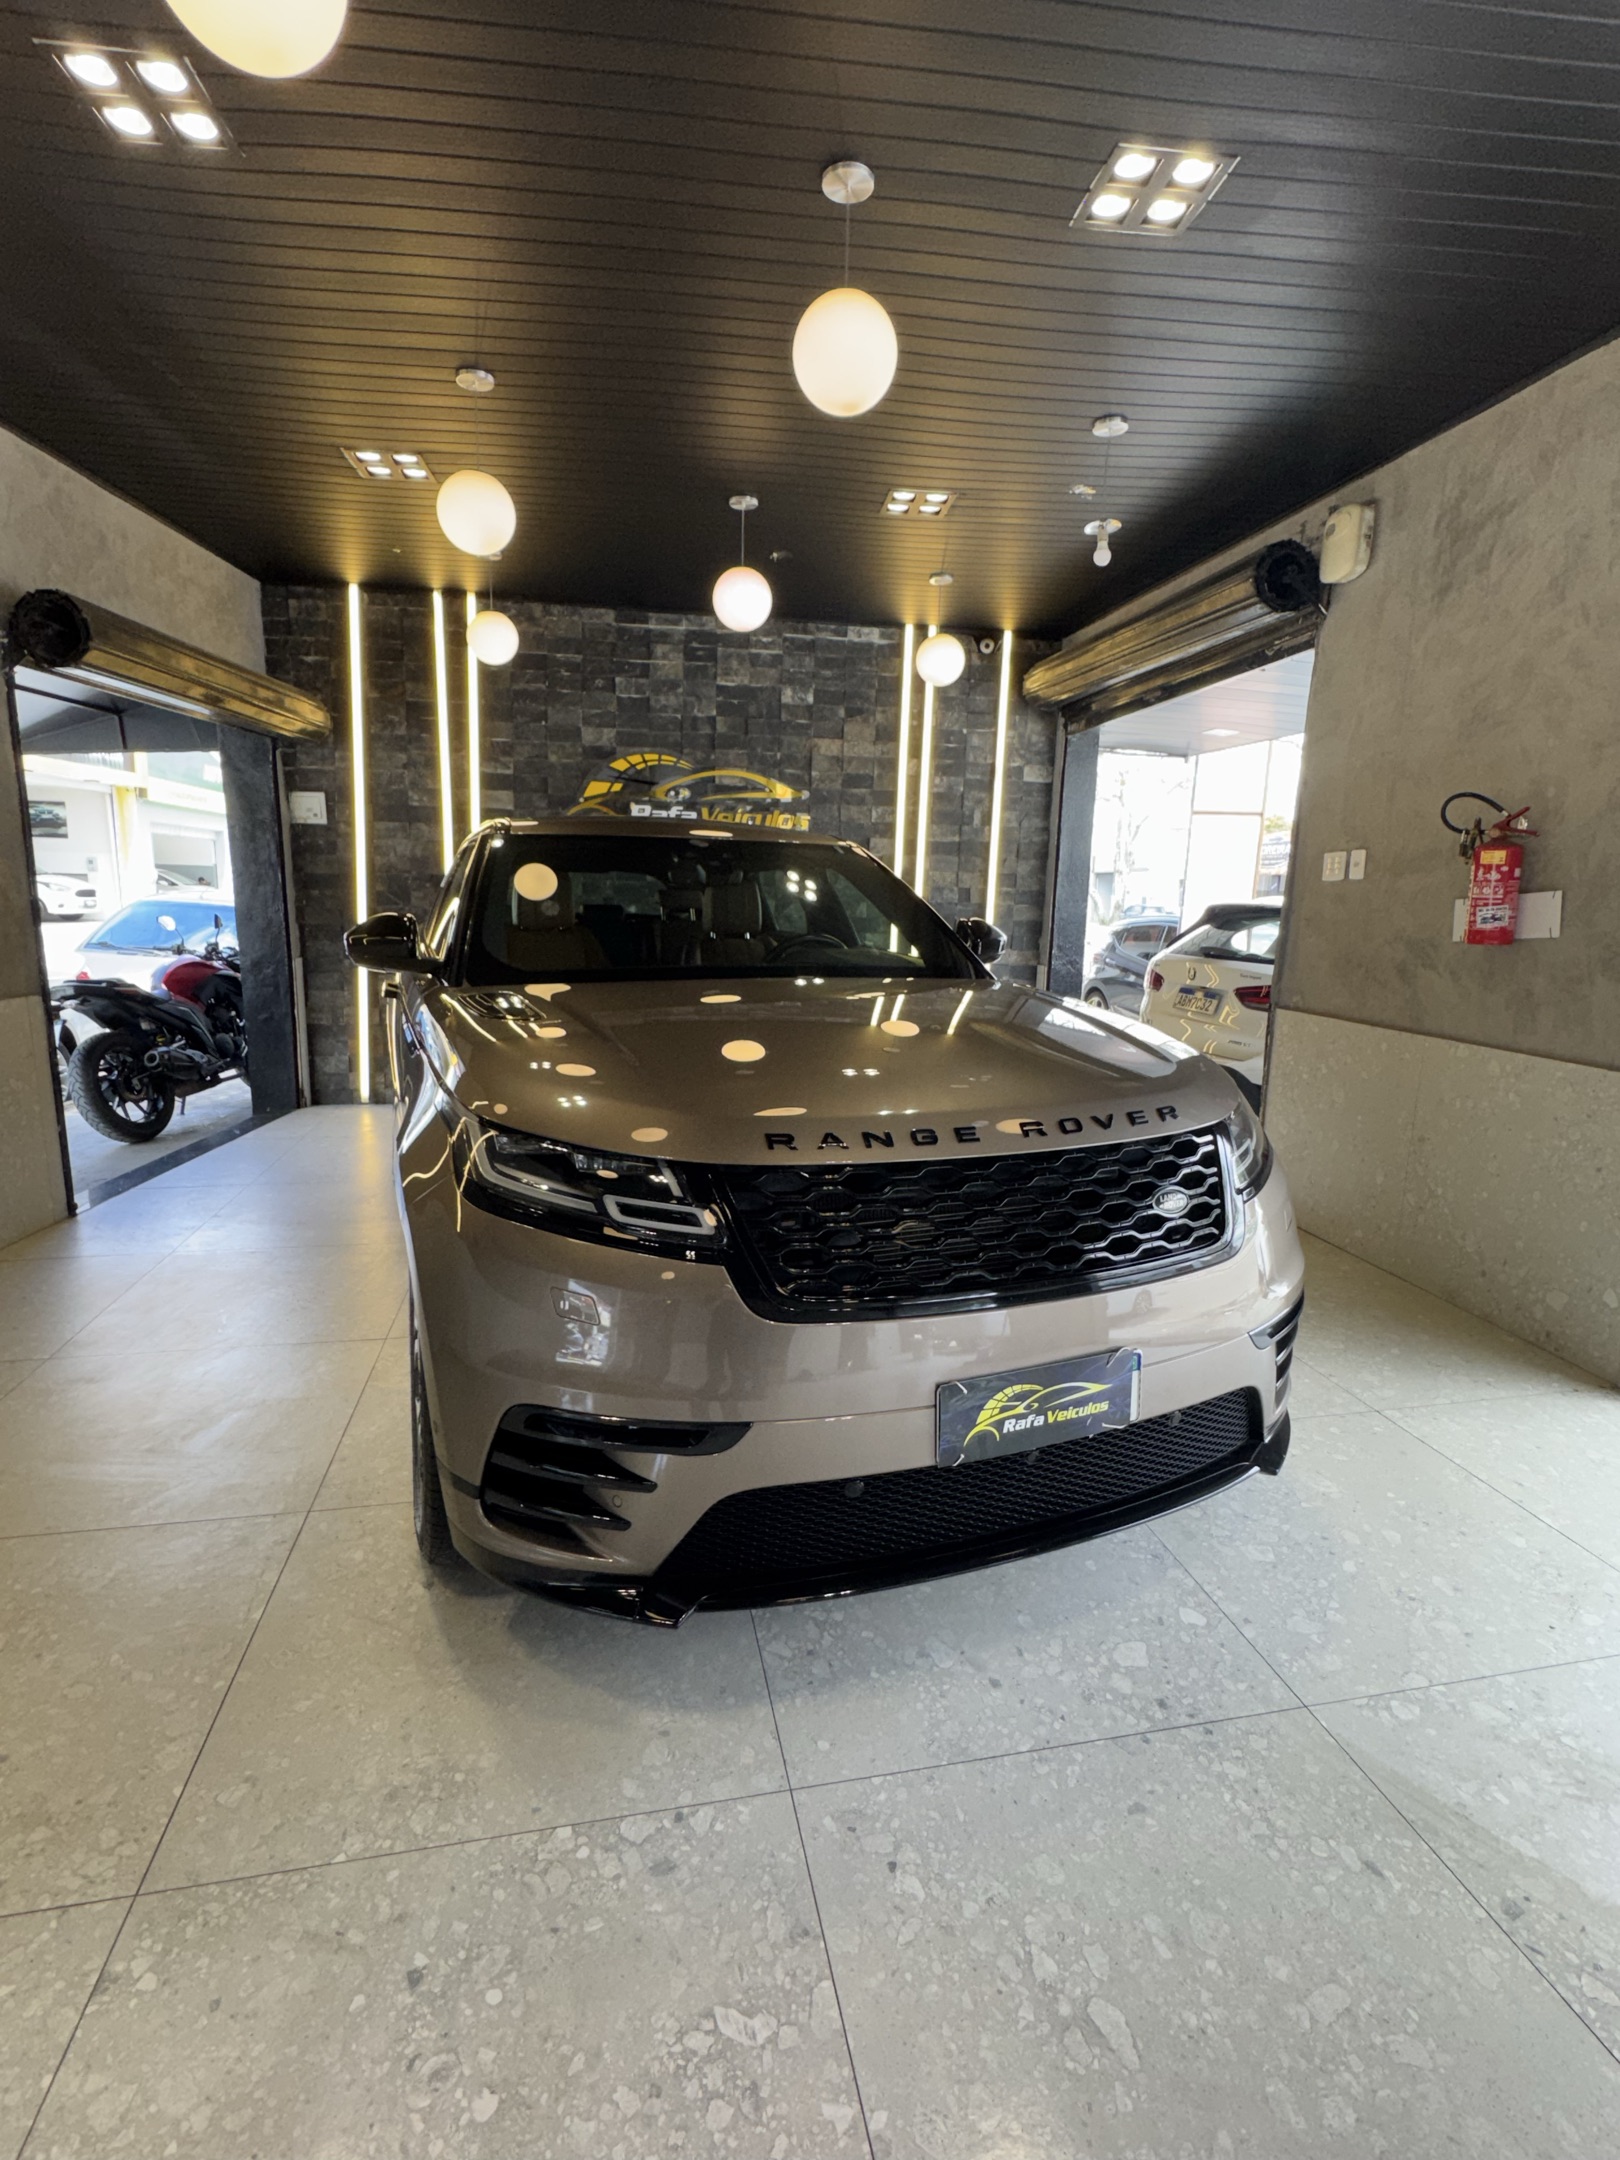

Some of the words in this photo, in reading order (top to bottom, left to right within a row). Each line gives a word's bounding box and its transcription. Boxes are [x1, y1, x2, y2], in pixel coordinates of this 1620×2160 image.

[764, 1125, 981, 1151] RANGE
[1020, 1105, 1181, 1138] ROVER
[1159, 1193, 1177, 1203] LAND
[1003, 1414, 1045, 1434] Rafa
[1047, 1400, 1110, 1424] Veiculos
